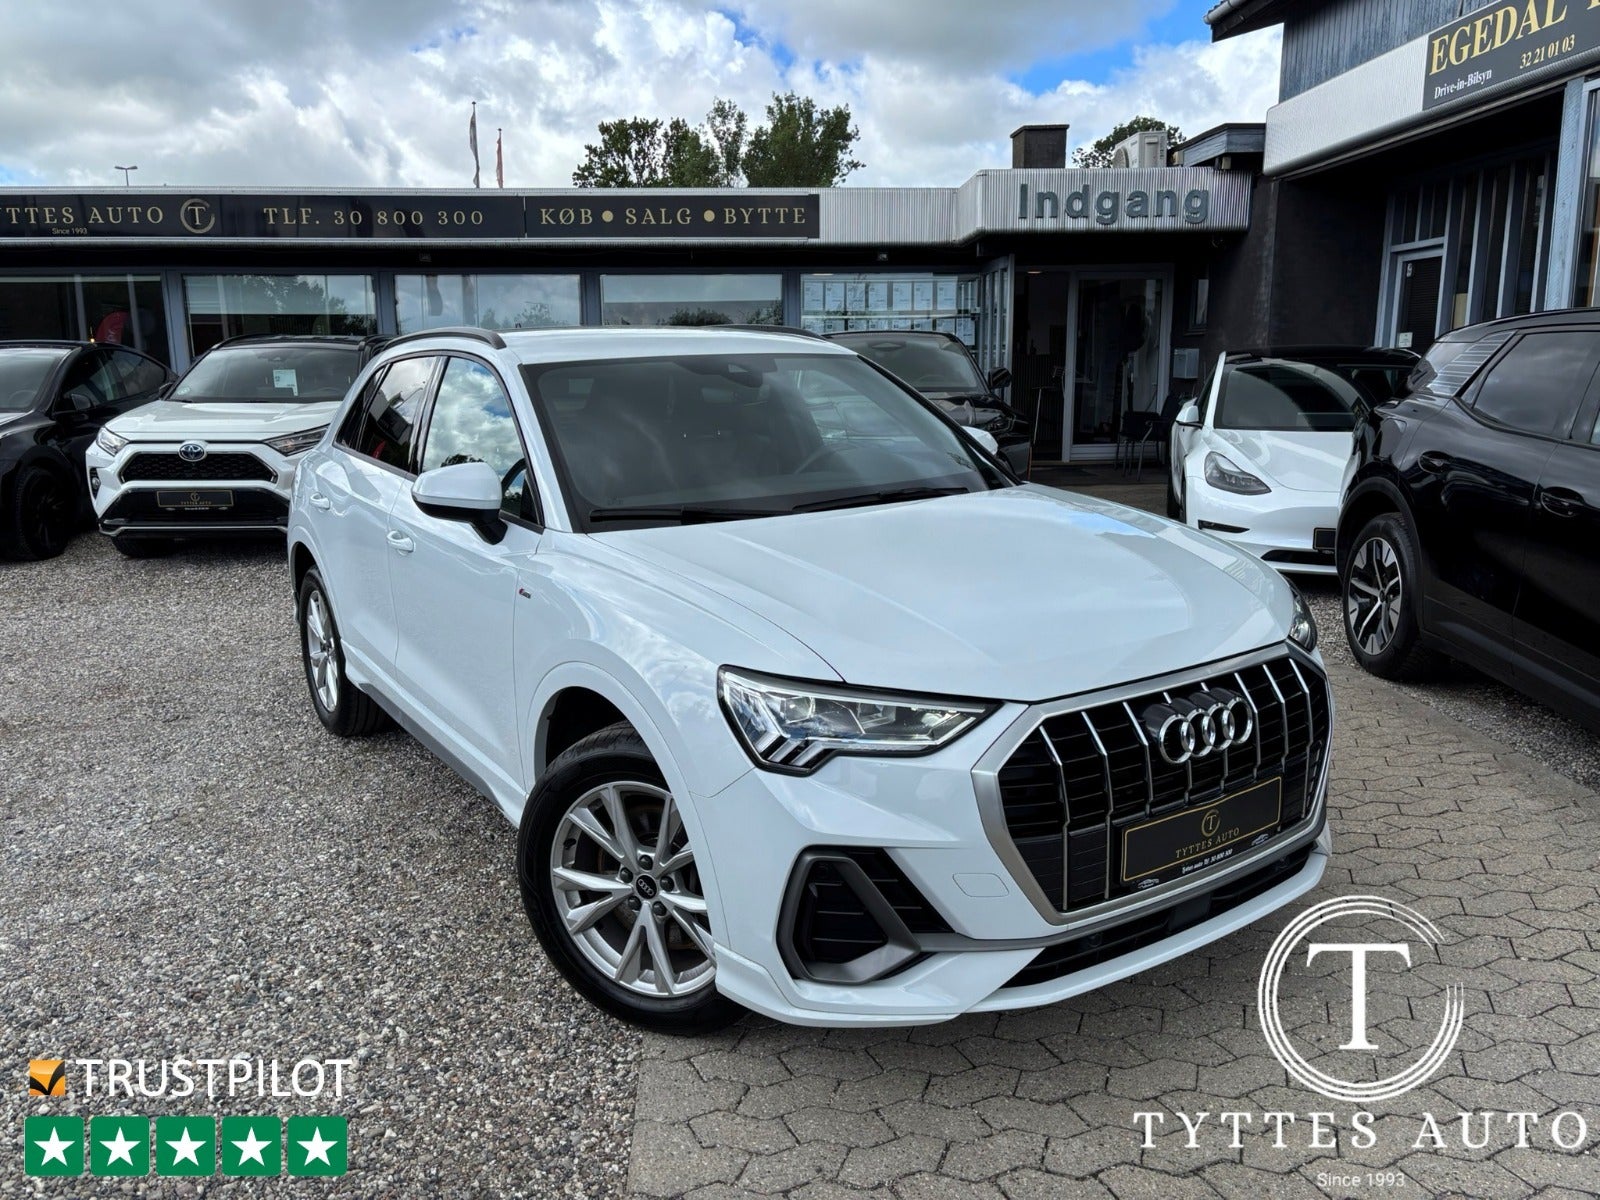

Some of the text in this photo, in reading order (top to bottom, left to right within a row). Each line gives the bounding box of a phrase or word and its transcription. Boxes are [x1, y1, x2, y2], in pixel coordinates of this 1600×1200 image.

[1429, 0, 1568, 76] EGEDAL
[1519, 34, 1575, 69] 32 21 01 03
[1434, 69, 1493, 99] Drive-in-Bilsyn
[0, 206, 164, 225] TTES AUTO
[263, 207, 484, 226] TLF. 30 800 300
[540, 207, 807, 226] KØB SALG BYTTE
[1018, 183, 1210, 226] Indgang
[52, 227, 88, 235] Since 1993
[1175, 827, 1240, 859] TYTTES AUTO
